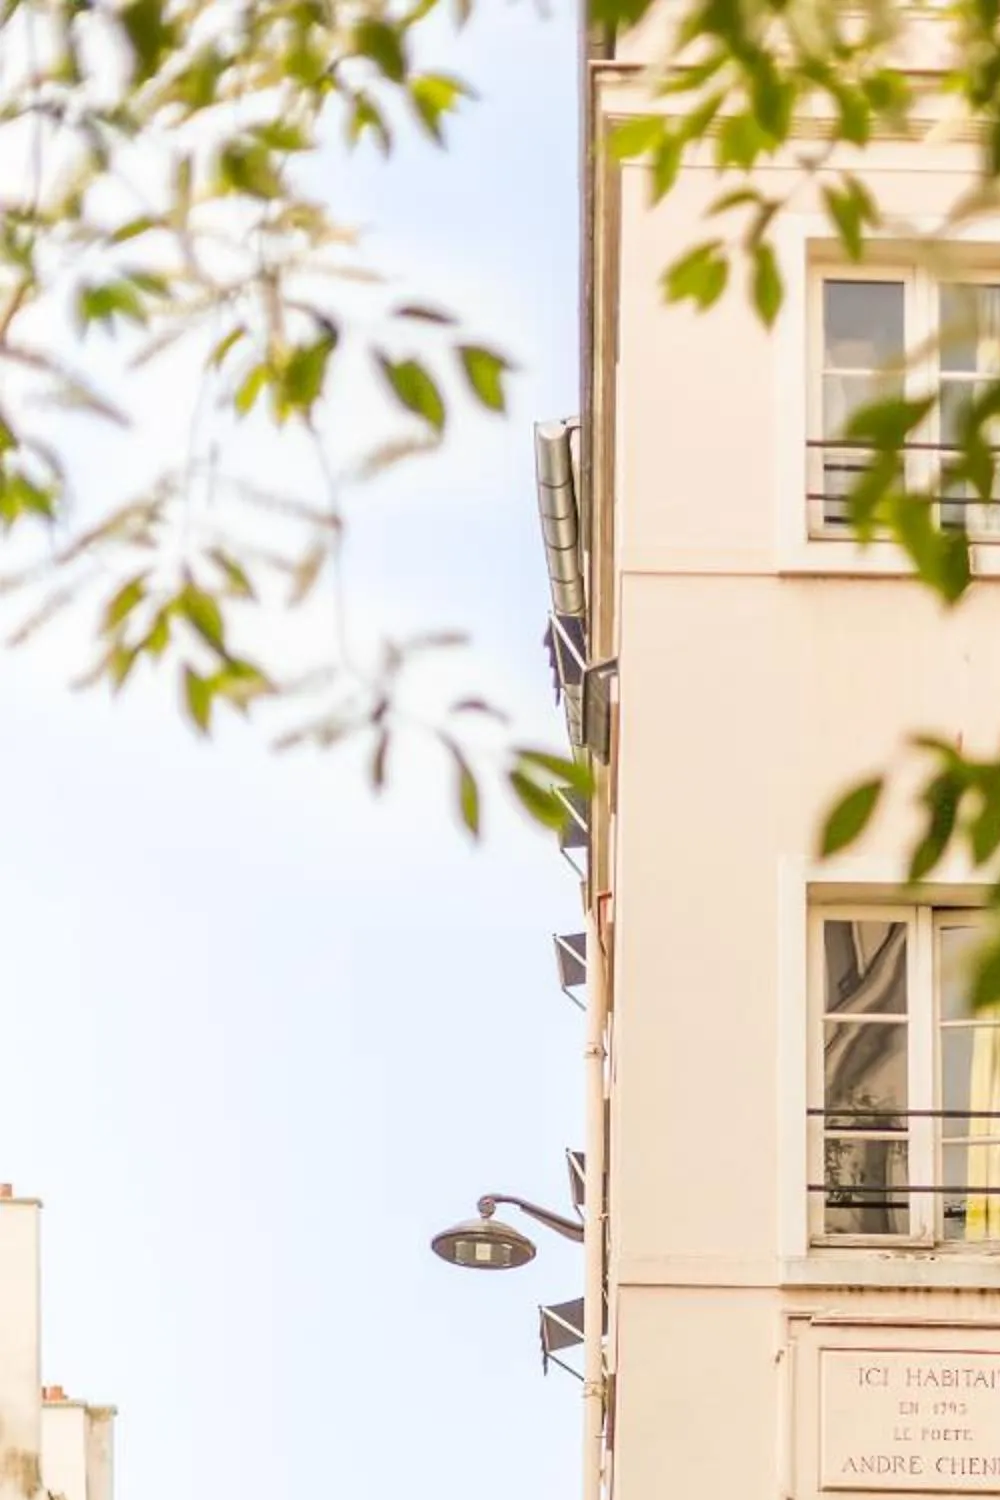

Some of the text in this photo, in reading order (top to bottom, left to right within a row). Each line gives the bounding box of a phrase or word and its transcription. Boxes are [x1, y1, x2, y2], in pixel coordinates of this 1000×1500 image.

[858, 1367, 889, 1387] ICI
[899, 1401, 919, 1415] EN
[894, 1426, 912, 1441] LE
[842, 1456, 923, 1475] ANDRE
